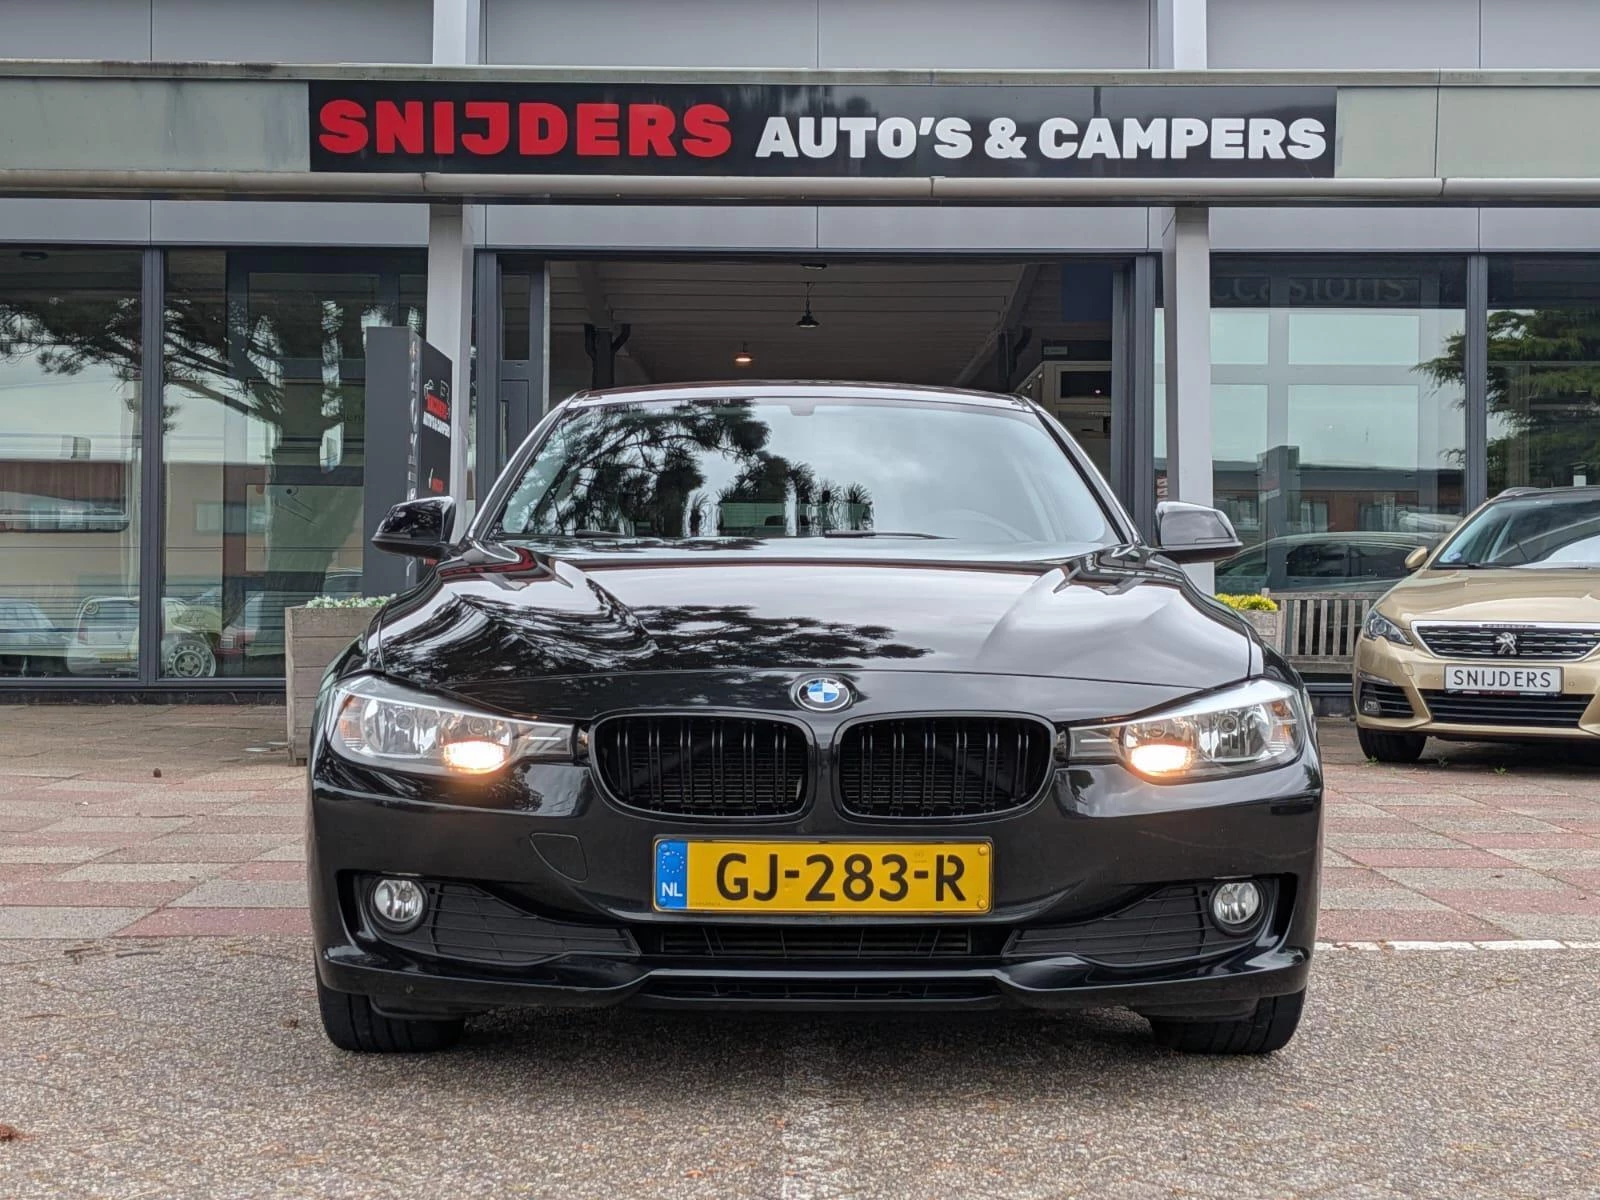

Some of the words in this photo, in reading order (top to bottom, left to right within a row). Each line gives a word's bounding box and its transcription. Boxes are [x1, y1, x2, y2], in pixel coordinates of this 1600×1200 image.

[319, 99, 732, 158] SNIJDERS
[755, 116, 972, 160] AUTO'S
[984, 117, 1027, 159] &
[1038, 117, 1327, 160] CAMPERS
[1453, 669, 1552, 688] SNIJDERS
[661, 882, 683, 897] NL
[716, 852, 967, 902] GJ-283-R
